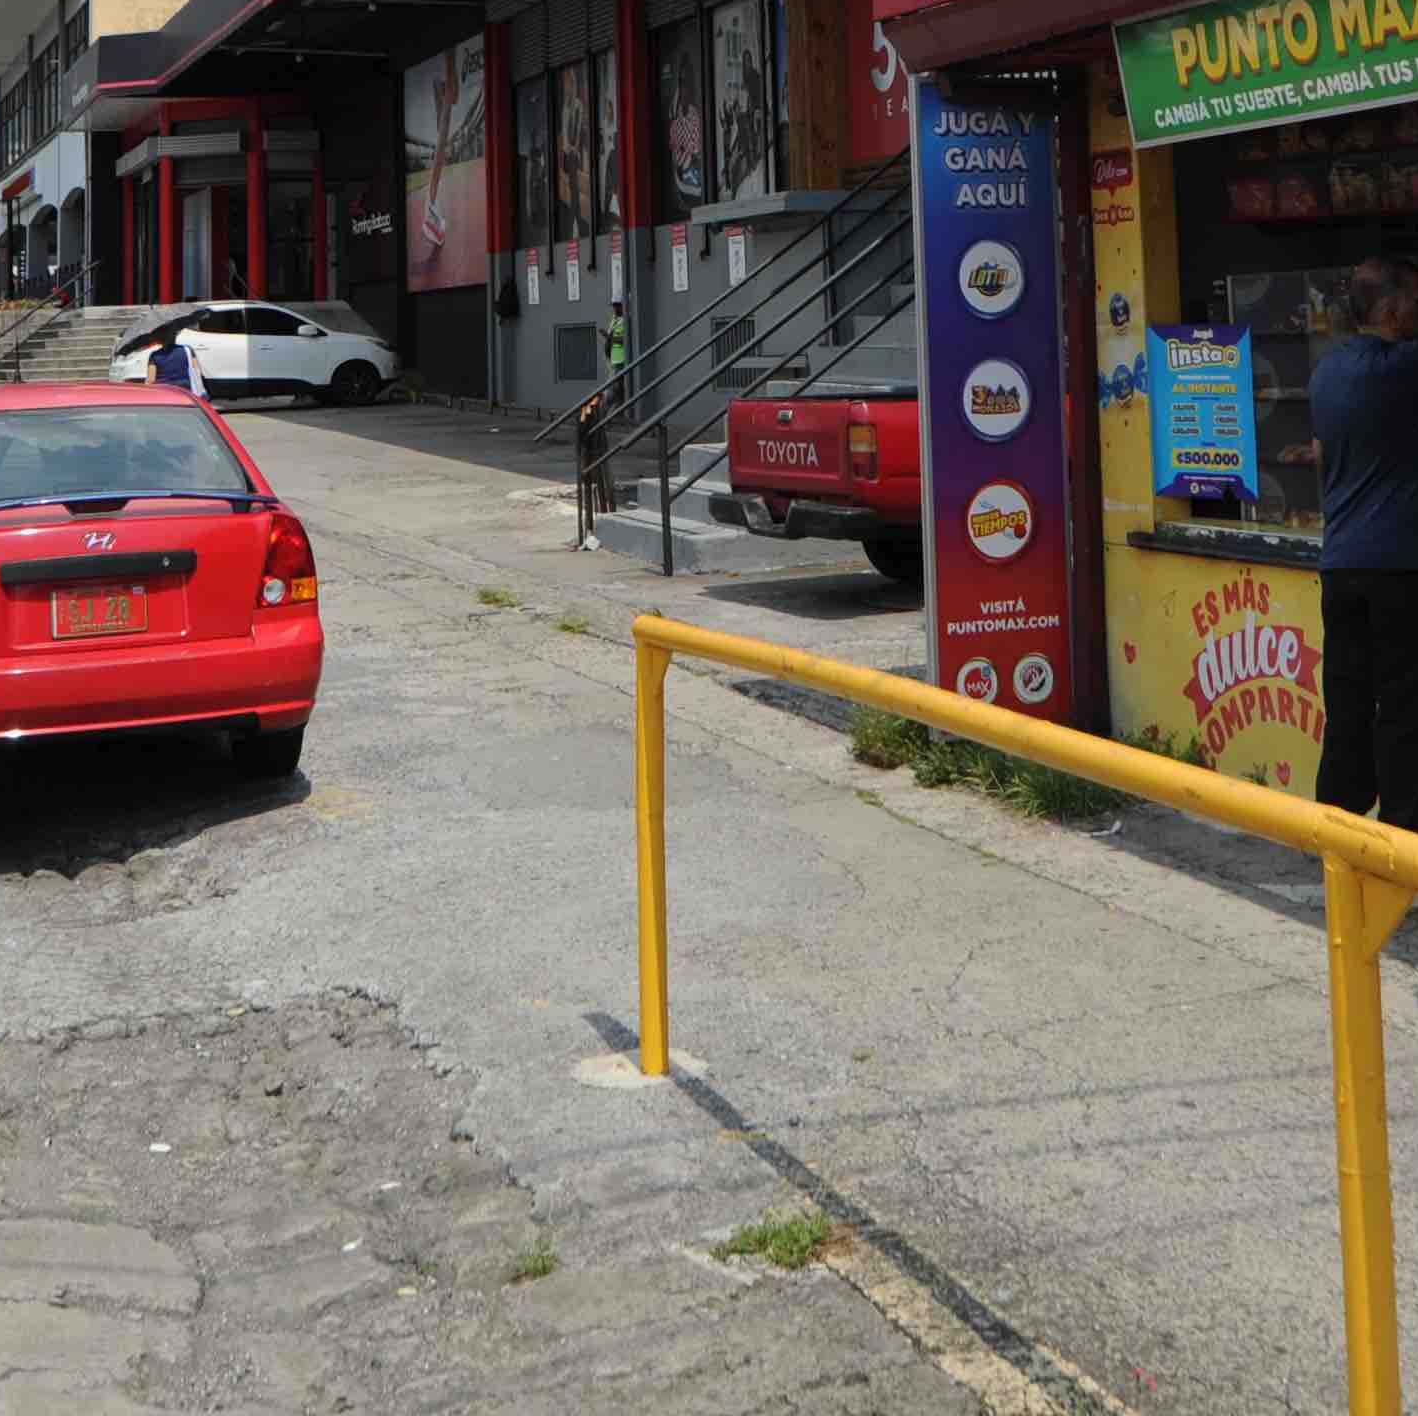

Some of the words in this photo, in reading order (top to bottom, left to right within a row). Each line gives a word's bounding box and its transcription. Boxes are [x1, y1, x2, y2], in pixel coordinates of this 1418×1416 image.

[1154, 90, 1210, 129] CAMBIÁ
[1210, 94, 1233, 117] TU
[1235, 84, 1303, 115] SUERTE,
[1304, 61, 1374, 101] CAMBIÁ
[1375, 59, 1415, 85] TUS
[933, 104, 1010, 136] JUGÁ
[1016, 110, 1035, 134] Y
[944, 142, 1028, 172] GANÁ
[956, 180, 1028, 209] AQUÍ
[1170, 341, 1224, 368] insta
[758, 439, 819, 467] TOYOTA
[980, 595, 1026, 615] VISITÁ
[1192, 598, 1221, 634] ES
[1223, 567, 1270, 615] MÁS
[947, 614, 1061, 635] PUNTOMAX.COM
[1197, 618, 1302, 702] dulce
